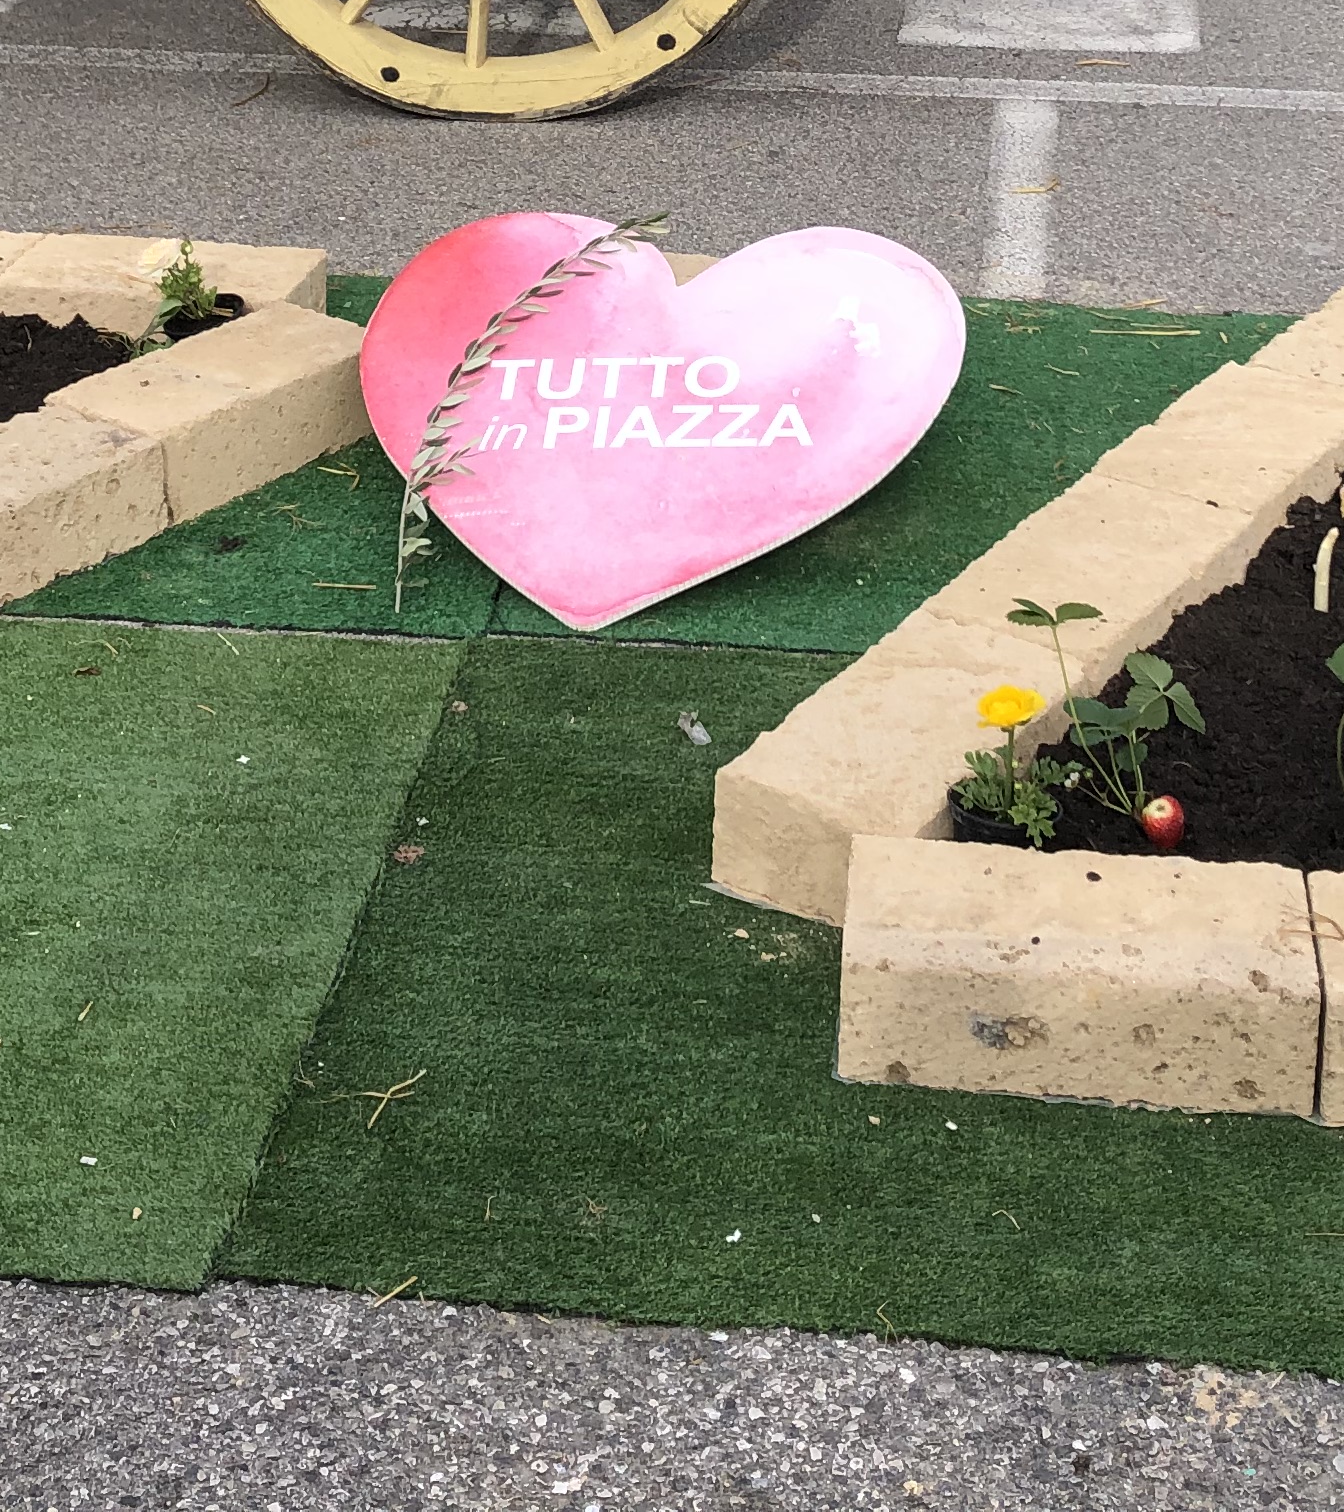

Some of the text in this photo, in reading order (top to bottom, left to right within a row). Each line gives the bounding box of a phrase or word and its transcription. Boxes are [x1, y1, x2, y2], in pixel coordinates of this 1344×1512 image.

[490, 355, 741, 400] TUTTO
[477, 403, 814, 451] in PIAZZA
